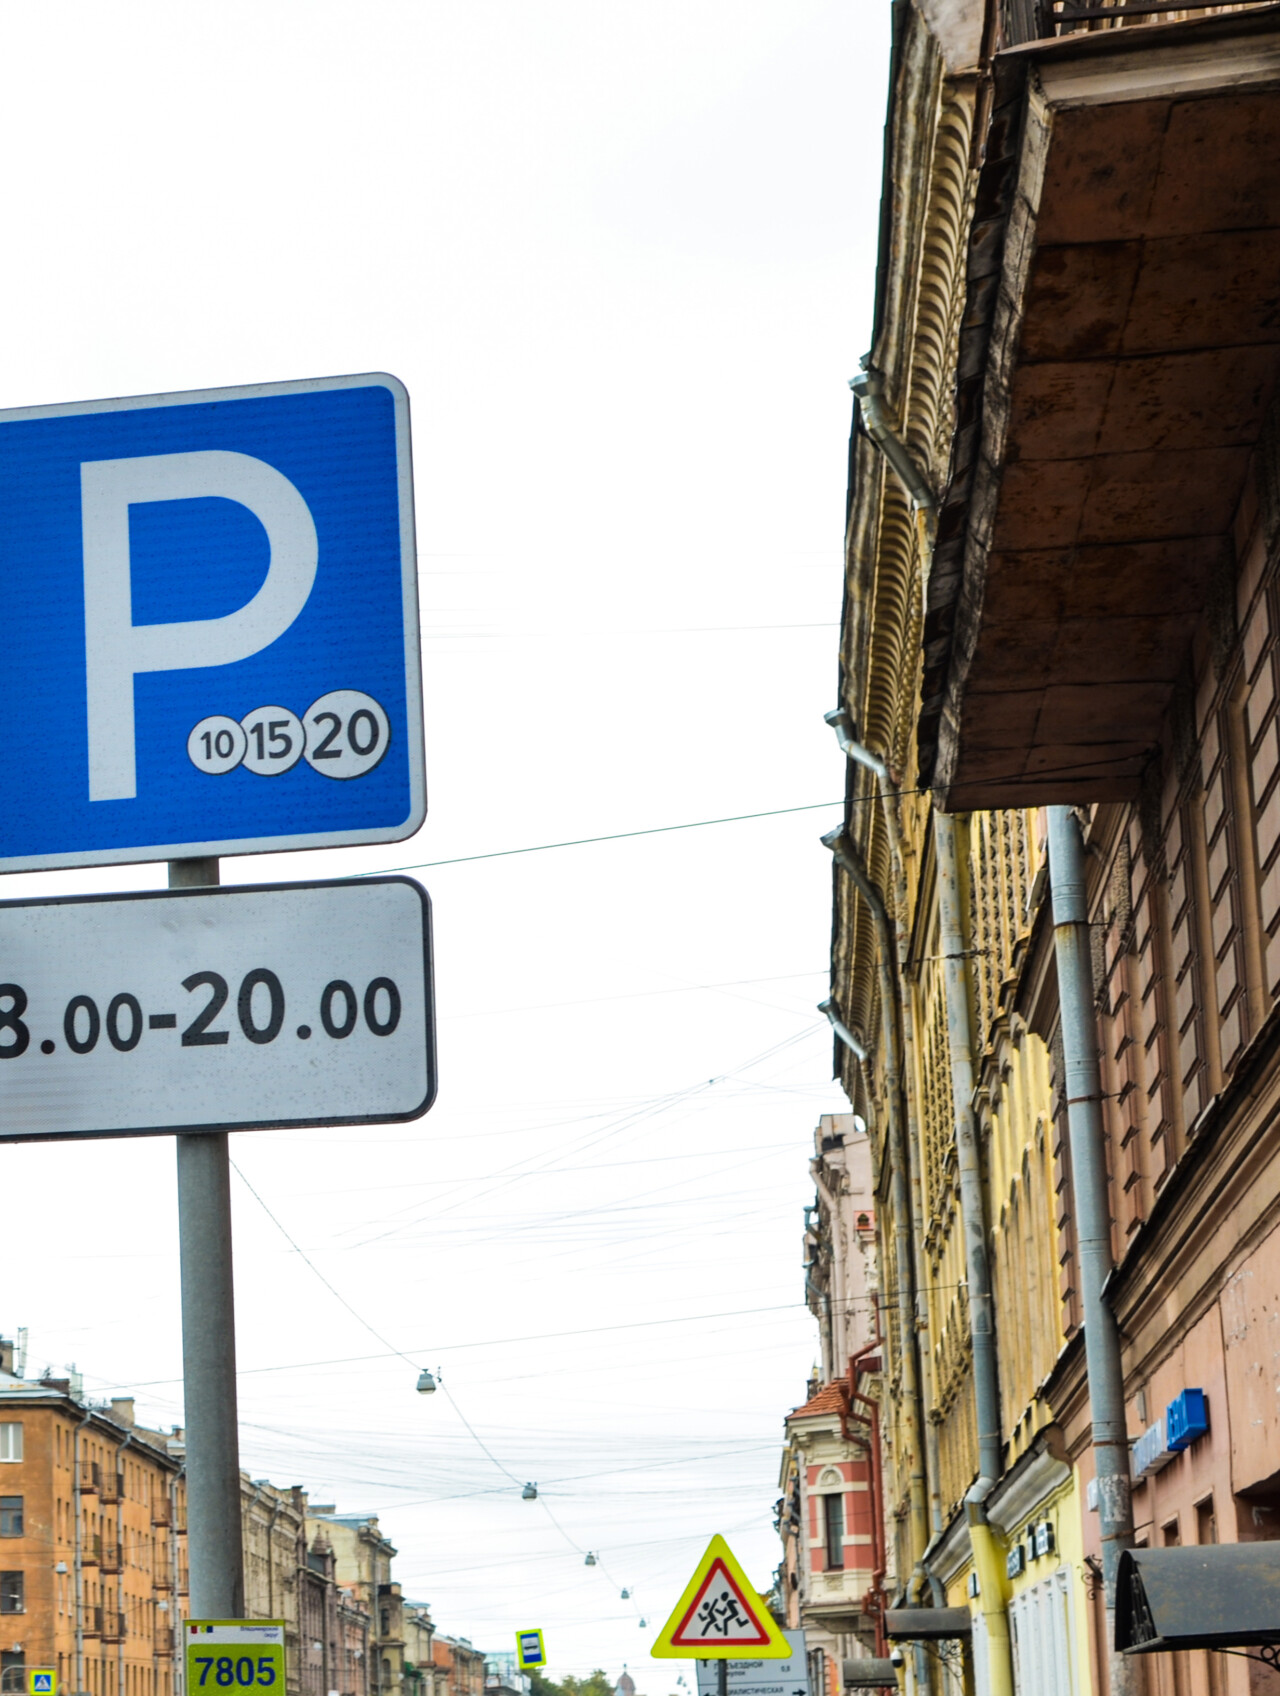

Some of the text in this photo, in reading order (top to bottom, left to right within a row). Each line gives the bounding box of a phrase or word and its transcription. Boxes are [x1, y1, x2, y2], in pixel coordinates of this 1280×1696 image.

[80, 449, 319, 802] P
[200, 708, 380, 760] 10 15 20
[195, 1656, 276, 1687] 7805
